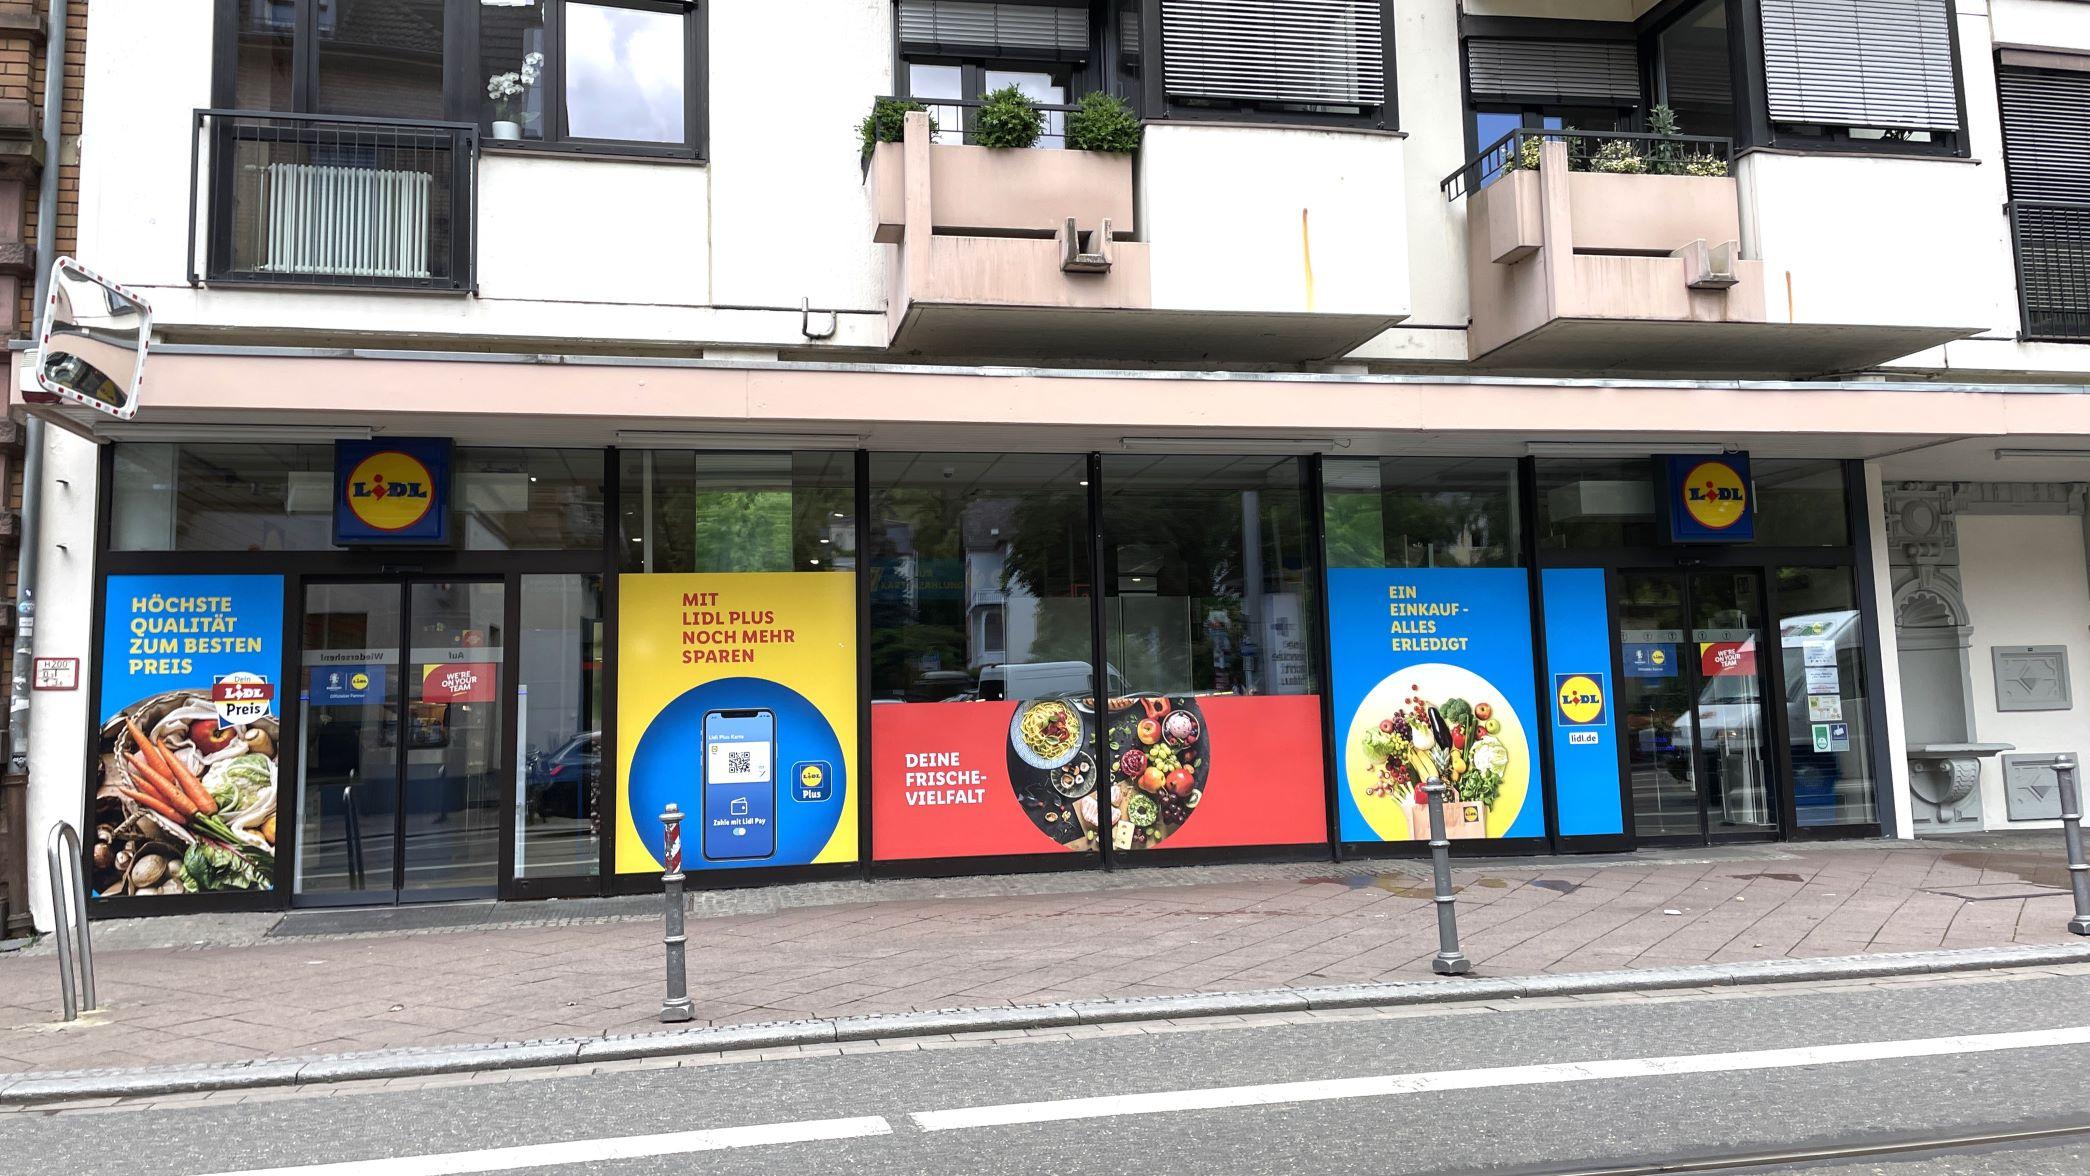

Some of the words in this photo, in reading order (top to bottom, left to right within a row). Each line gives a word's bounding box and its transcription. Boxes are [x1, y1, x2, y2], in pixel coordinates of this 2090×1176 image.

[683, 592, 719, 607] MIT
[1389, 586, 1417, 599] EIN
[132, 593, 232, 613] HÖCHSTE
[130, 613, 238, 637] QUALITÄT
[682, 611, 725, 626] LIDL
[729, 610, 774, 625] PLUS
[1391, 620, 1437, 634] ALLES
[682, 630, 737, 645] NOCH
[742, 629, 795, 643] MEHR
[1392, 637, 1469, 651] ERLEDIGT
[129, 638, 178, 655] ZUM
[184, 637, 262, 653] BESTEN
[682, 649, 754, 664] SPAREN
[1721, 659, 1737, 667] TEAM
[128, 658, 193, 675] PREIS
[441, 680, 454, 688] ON
[455, 676, 477, 685] YOUR
[447, 670, 471, 680] WE'RE
[449, 684, 471, 692] TEAM
[226, 702, 261, 716] Preis
[1571, 734, 1597, 743] lidl.de
[904, 752, 960, 768] DEINE
[905, 770, 987, 787] FRISCHE-
[802, 790, 821, 799] Plus
[905, 789, 986, 806] VIELFALT
[731, 818, 741, 826] mit
[742, 817, 753, 825] Lidl
[755, 817, 766, 826] Pay
